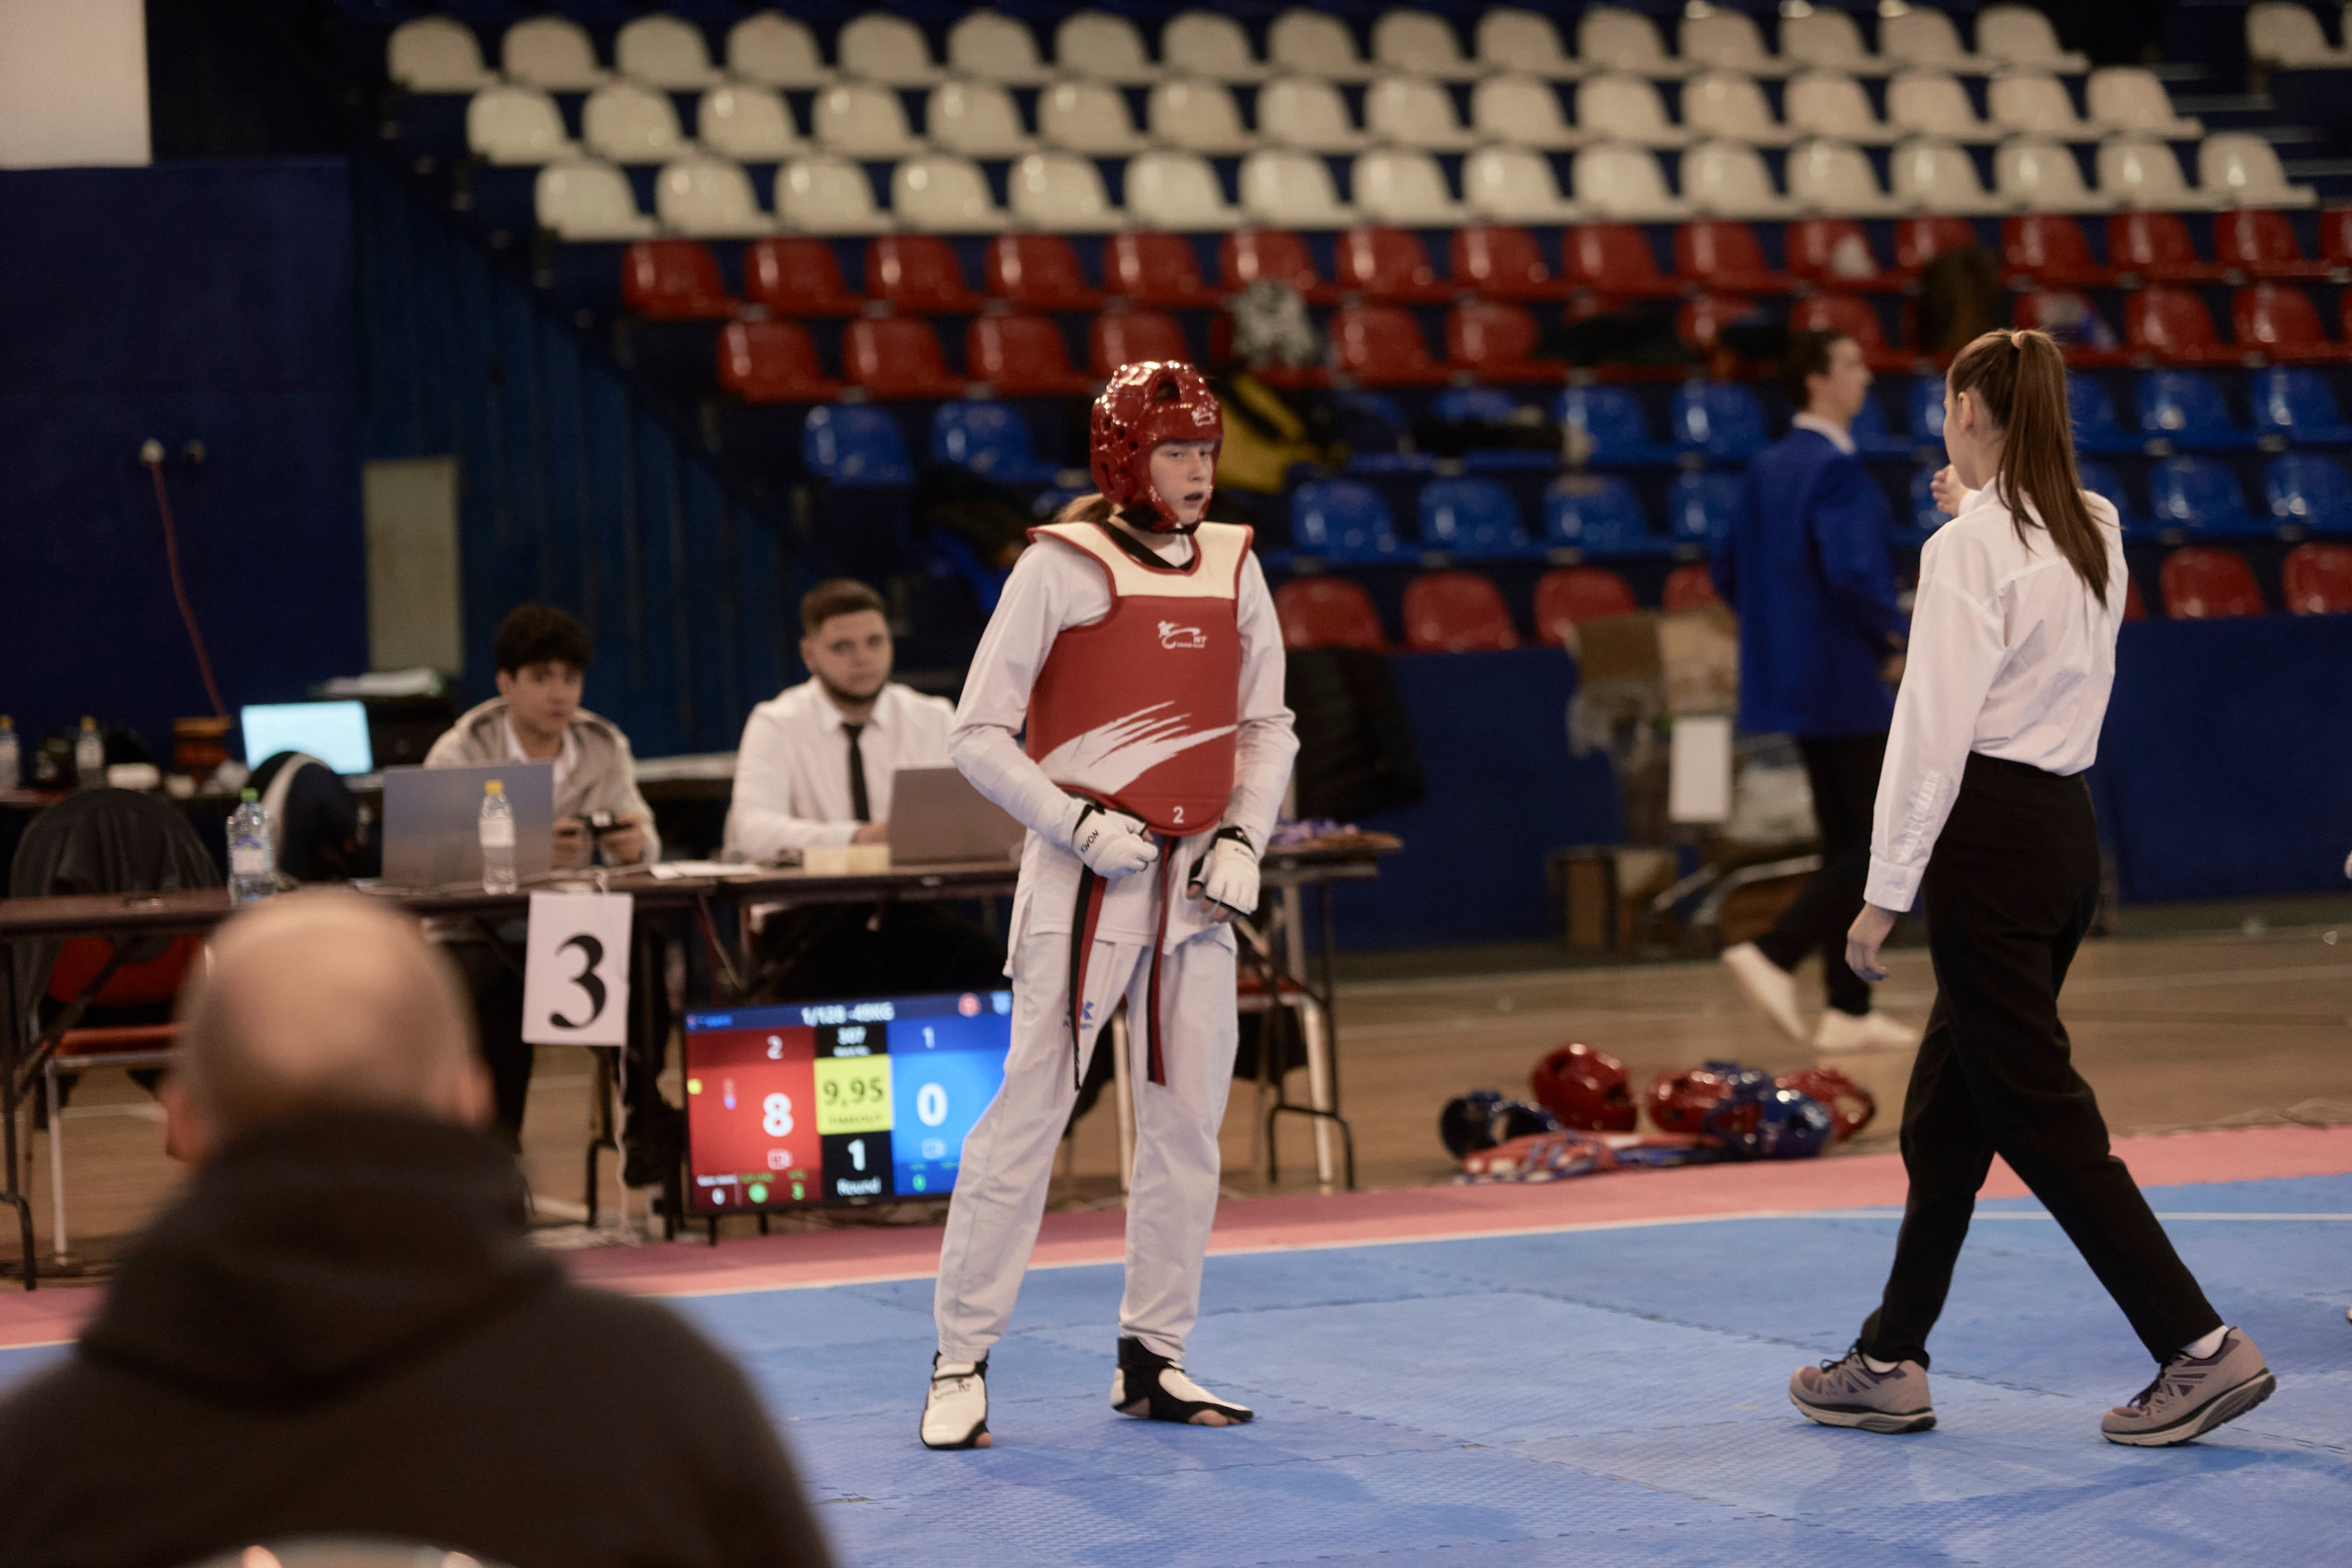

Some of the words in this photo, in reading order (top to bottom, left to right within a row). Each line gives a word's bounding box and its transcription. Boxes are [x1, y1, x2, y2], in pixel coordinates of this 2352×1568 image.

[1172, 806, 1184, 824] 2
[1079, 829, 1099, 854] KWON
[548, 932, 607, 1031] 3
[766, 1035, 784, 1060] 2
[922, 1026, 935, 1049] 1
[763, 1092, 794, 1137] 8
[917, 1082, 948, 1127] 0
[847, 1139, 866, 1171] 1
[837, 1176, 882, 1196] Round
